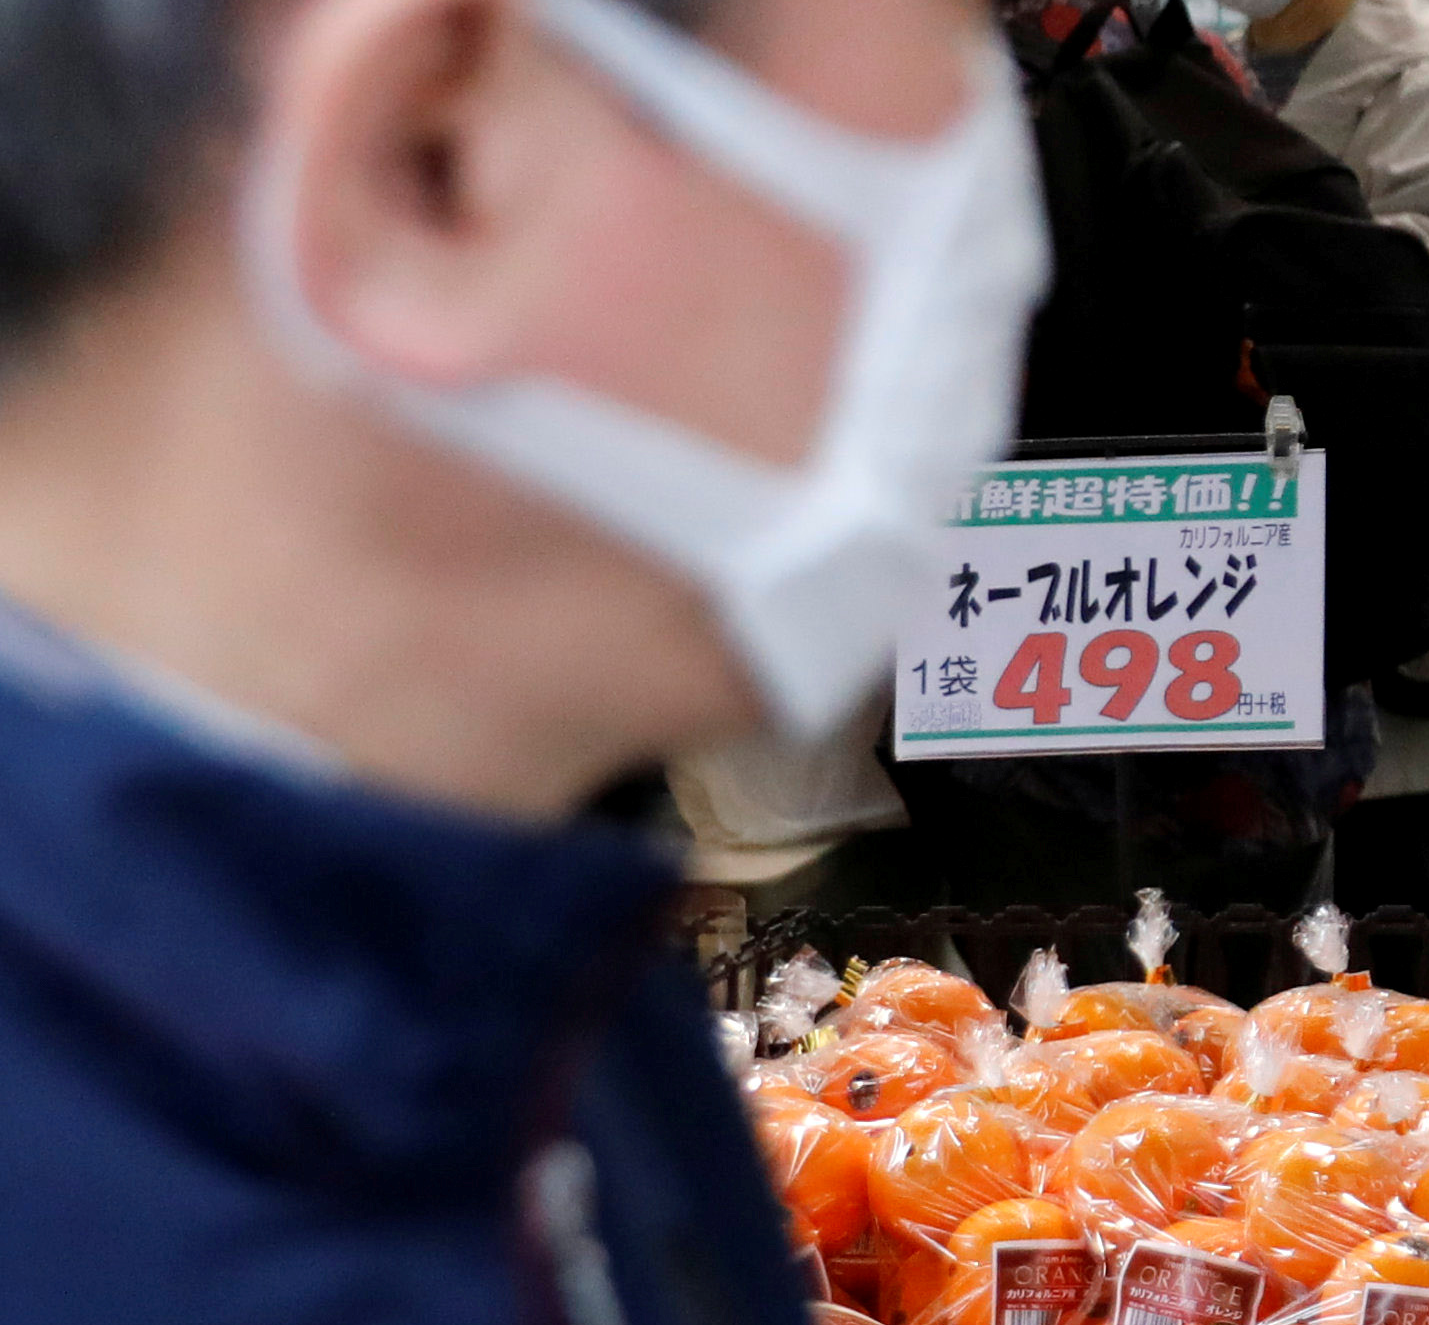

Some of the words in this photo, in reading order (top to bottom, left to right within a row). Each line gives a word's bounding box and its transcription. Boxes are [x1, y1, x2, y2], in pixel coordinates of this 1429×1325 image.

[1179, 523, 1292, 549] カリフォルニア産
[948, 554, 1258, 628] ネーブルオレンジ
[911, 656, 979, 697] 1袋
[993, 629, 1243, 725] 498
[1014, 1265, 1101, 1286] ORANG
[1138, 1265, 1244, 1307] ORANGE
[1130, 1286, 1197, 1310] カリフォルニア産
[1205, 1304, 1244, 1320] オレンジ
